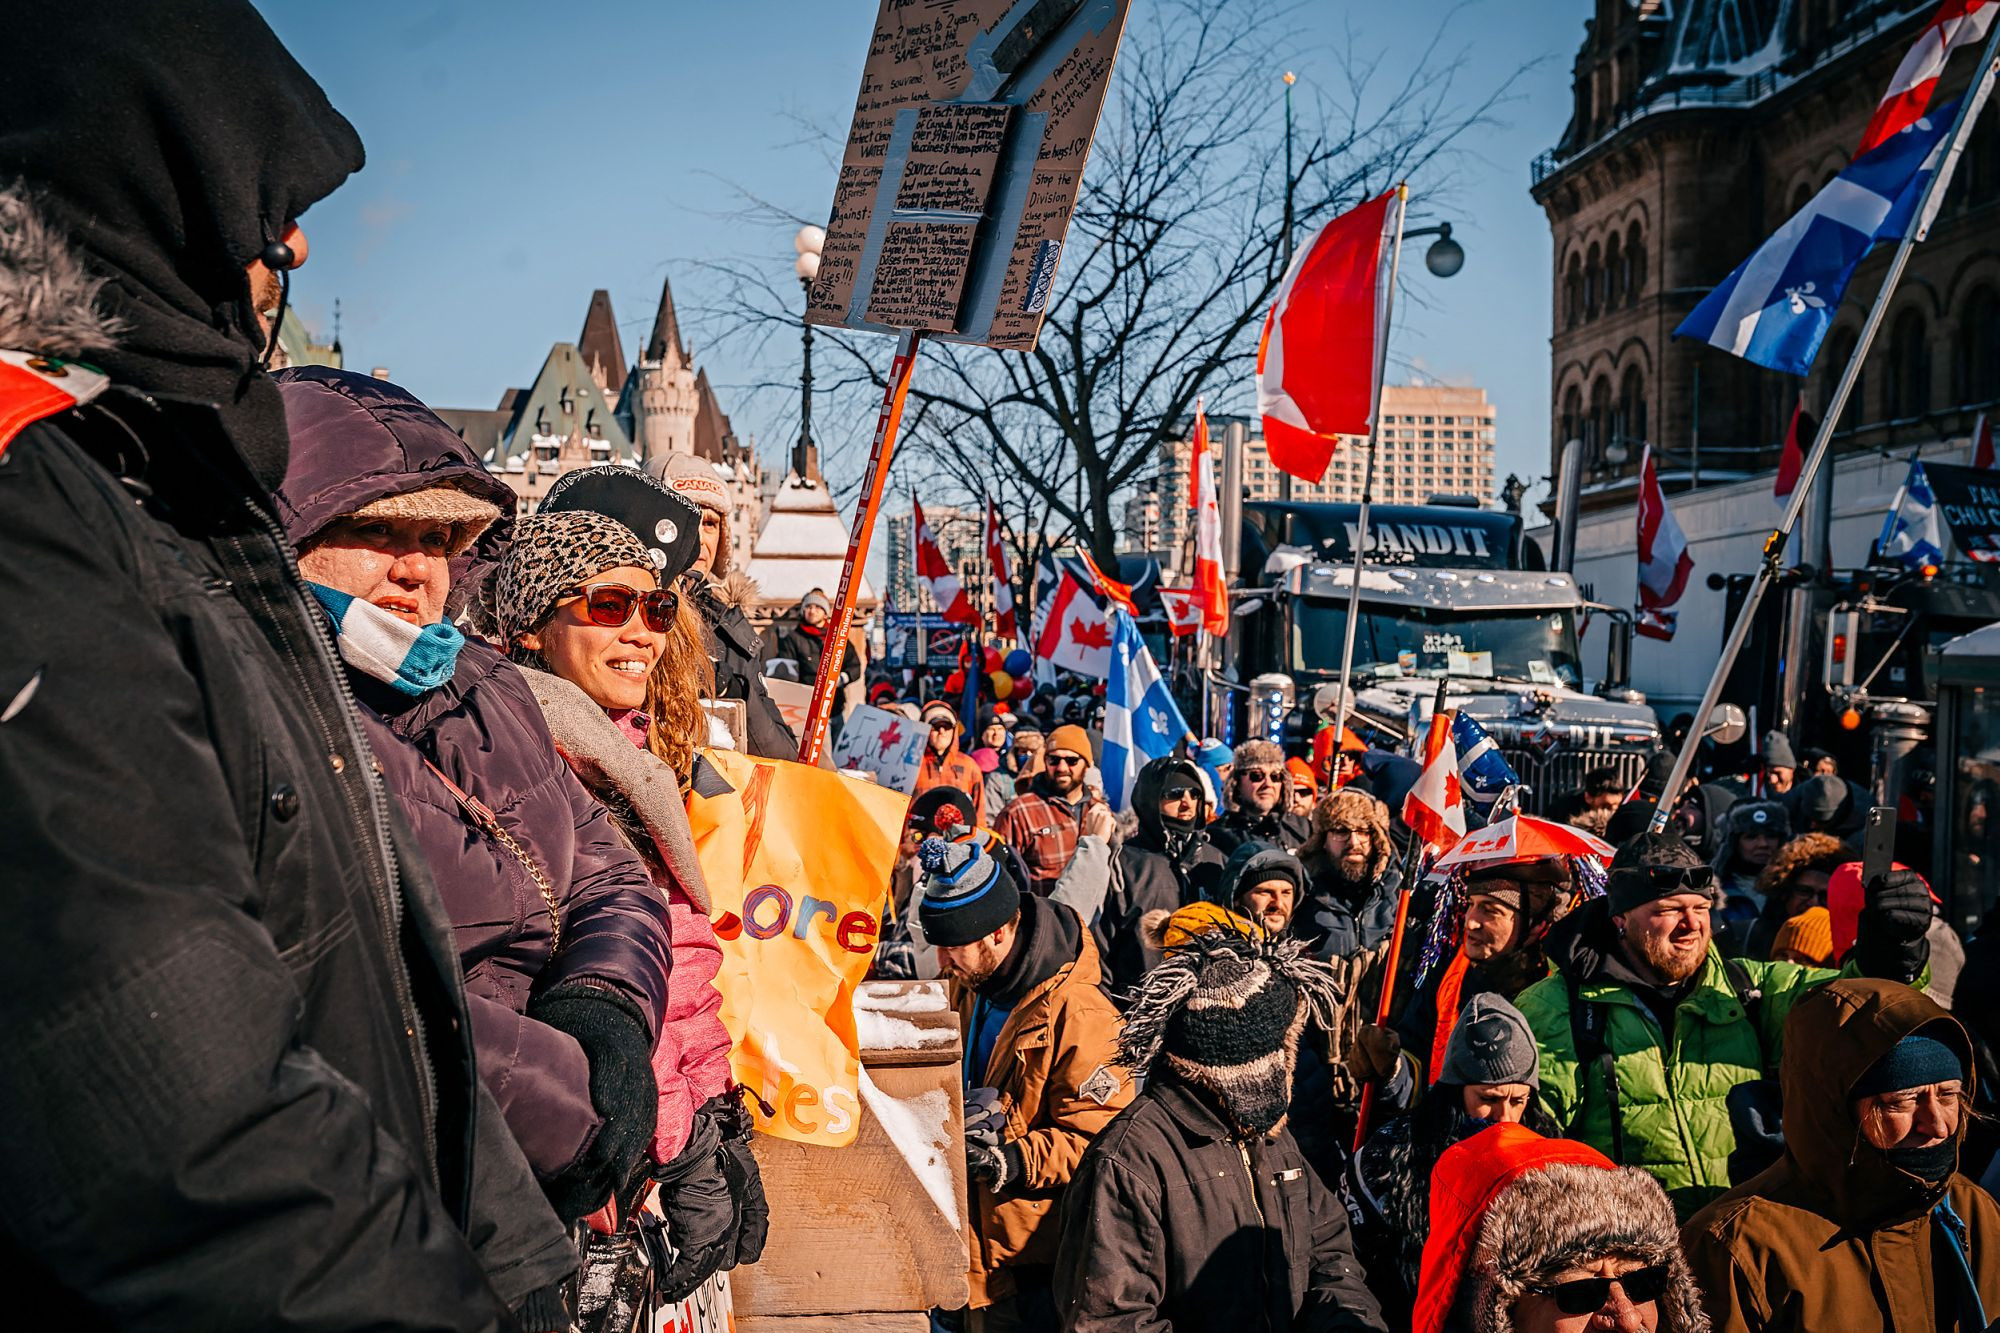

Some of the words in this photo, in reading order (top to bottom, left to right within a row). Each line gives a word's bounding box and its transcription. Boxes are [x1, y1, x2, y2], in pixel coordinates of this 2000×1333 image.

[896, 25, 904, 39] 2
[946, 13, 955, 29] 2
[895, 48, 921, 64] SAME
[932, 56, 950, 71] Keep
[951, 54, 960, 64] on
[905, 160, 938, 178] Source:
[1035, 173, 1054, 187] Stop
[1057, 171, 1072, 186] the
[890, 222, 923, 236] Canada
[847, 362, 903, 549] TITAN
[1343, 521, 1491, 558] BANDIT
[835, 560, 854, 611] PRO
[833, 649, 844, 672] made
[840, 607, 854, 636] Finland
[810, 680, 837, 763] TITAN
[712, 884, 878, 953] ore
